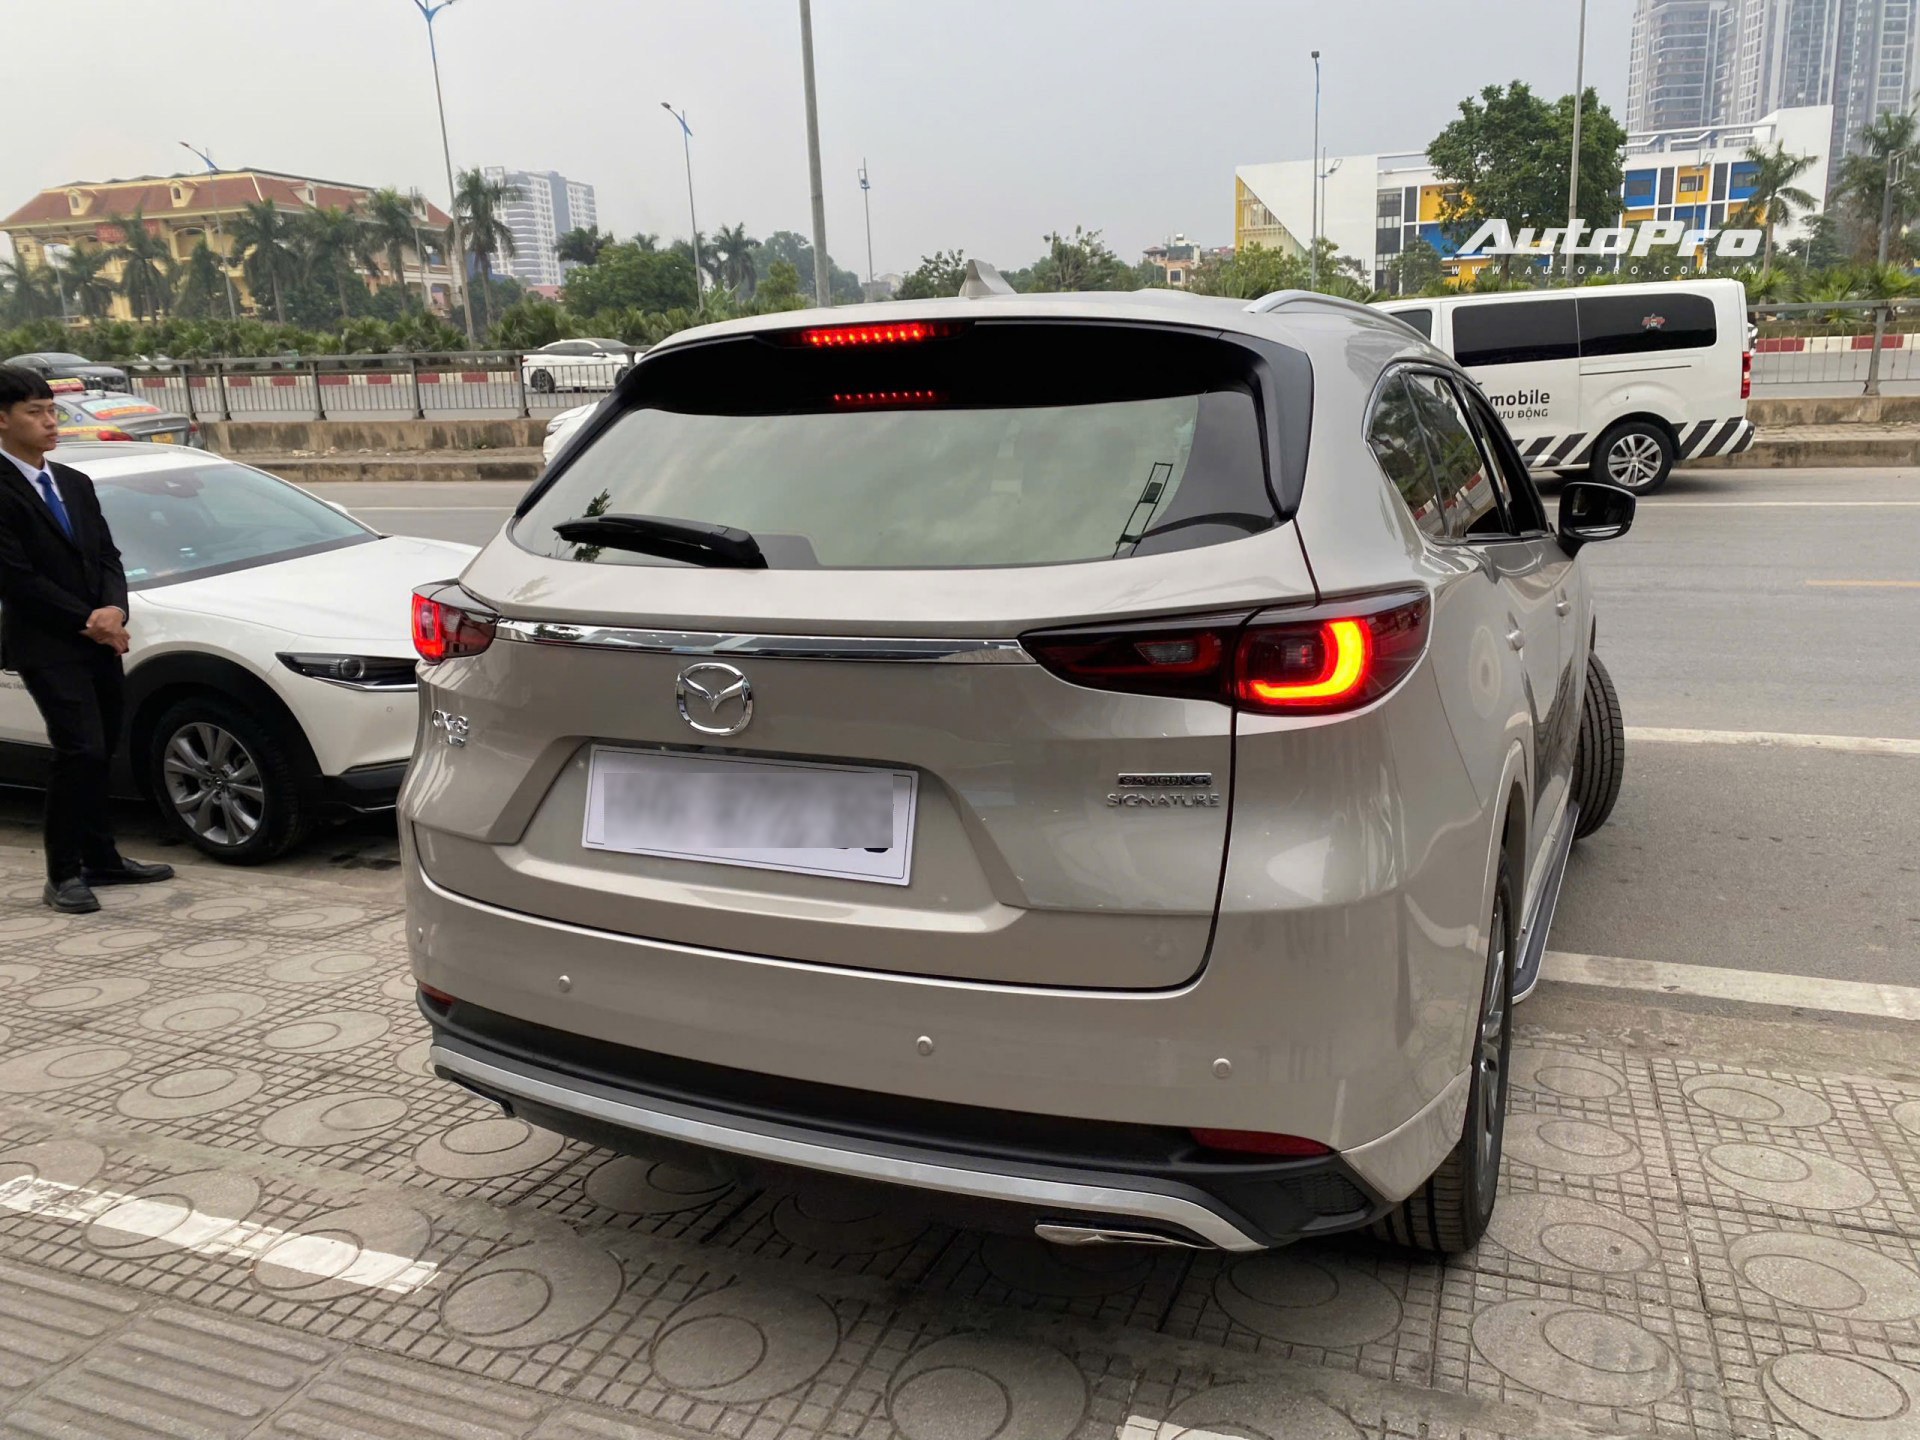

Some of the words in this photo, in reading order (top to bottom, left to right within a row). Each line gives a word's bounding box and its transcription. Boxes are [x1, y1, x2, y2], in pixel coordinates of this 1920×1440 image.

[1489, 388, 1551, 407] mobile
[1498, 410, 1514, 419] ƯU
[1517, 406, 1549, 420] ĐỘNG
[1105, 793, 1220, 808] SIGNATURE
